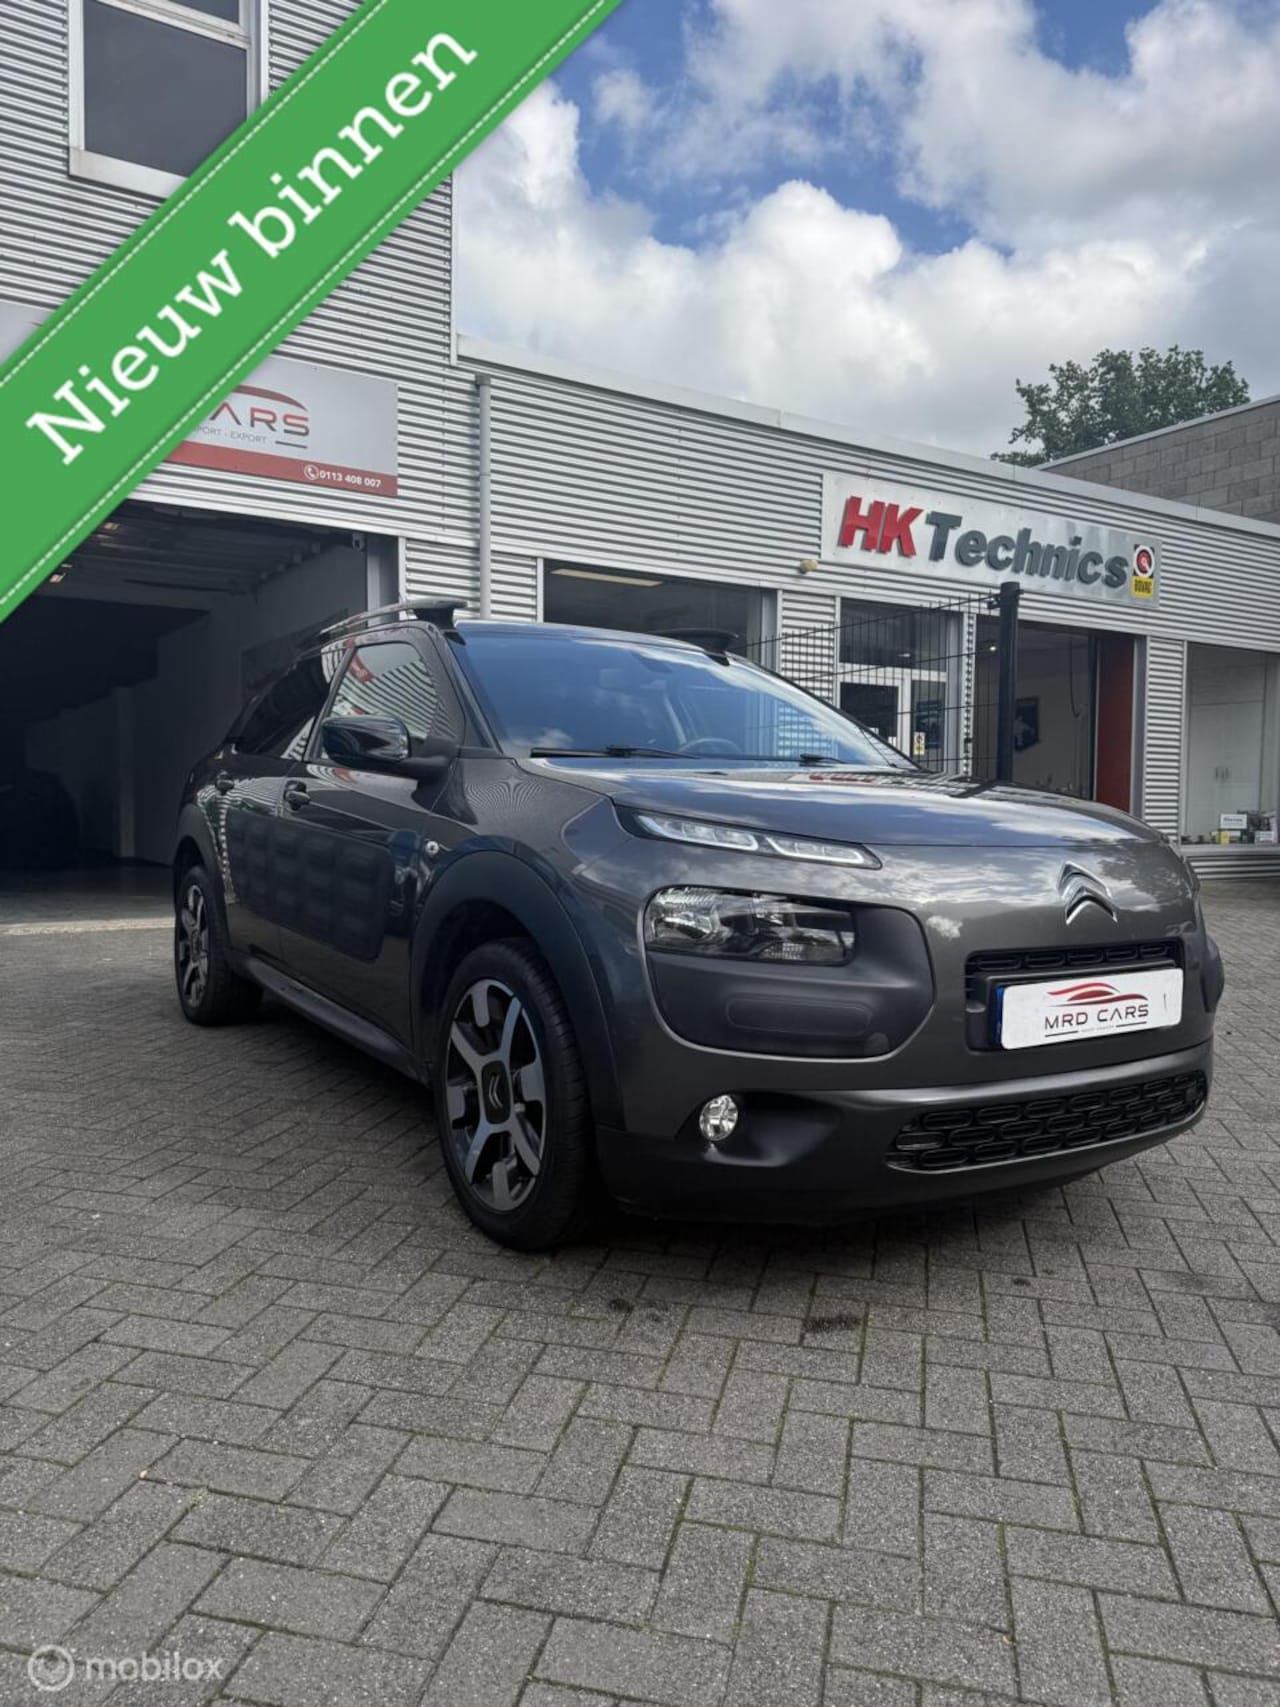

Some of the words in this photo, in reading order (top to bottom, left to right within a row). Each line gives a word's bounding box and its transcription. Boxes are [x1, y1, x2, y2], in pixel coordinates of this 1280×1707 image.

[209, 401, 310, 437] ARS
[230, 430, 267, 444] EXPORT
[319, 469, 343, 482] 0113
[363, 477, 382, 488] 007
[925, 510, 1131, 589] Technics
[1044, 1012, 1088, 1030] MRD
[1097, 1004, 1149, 1022] CARS
